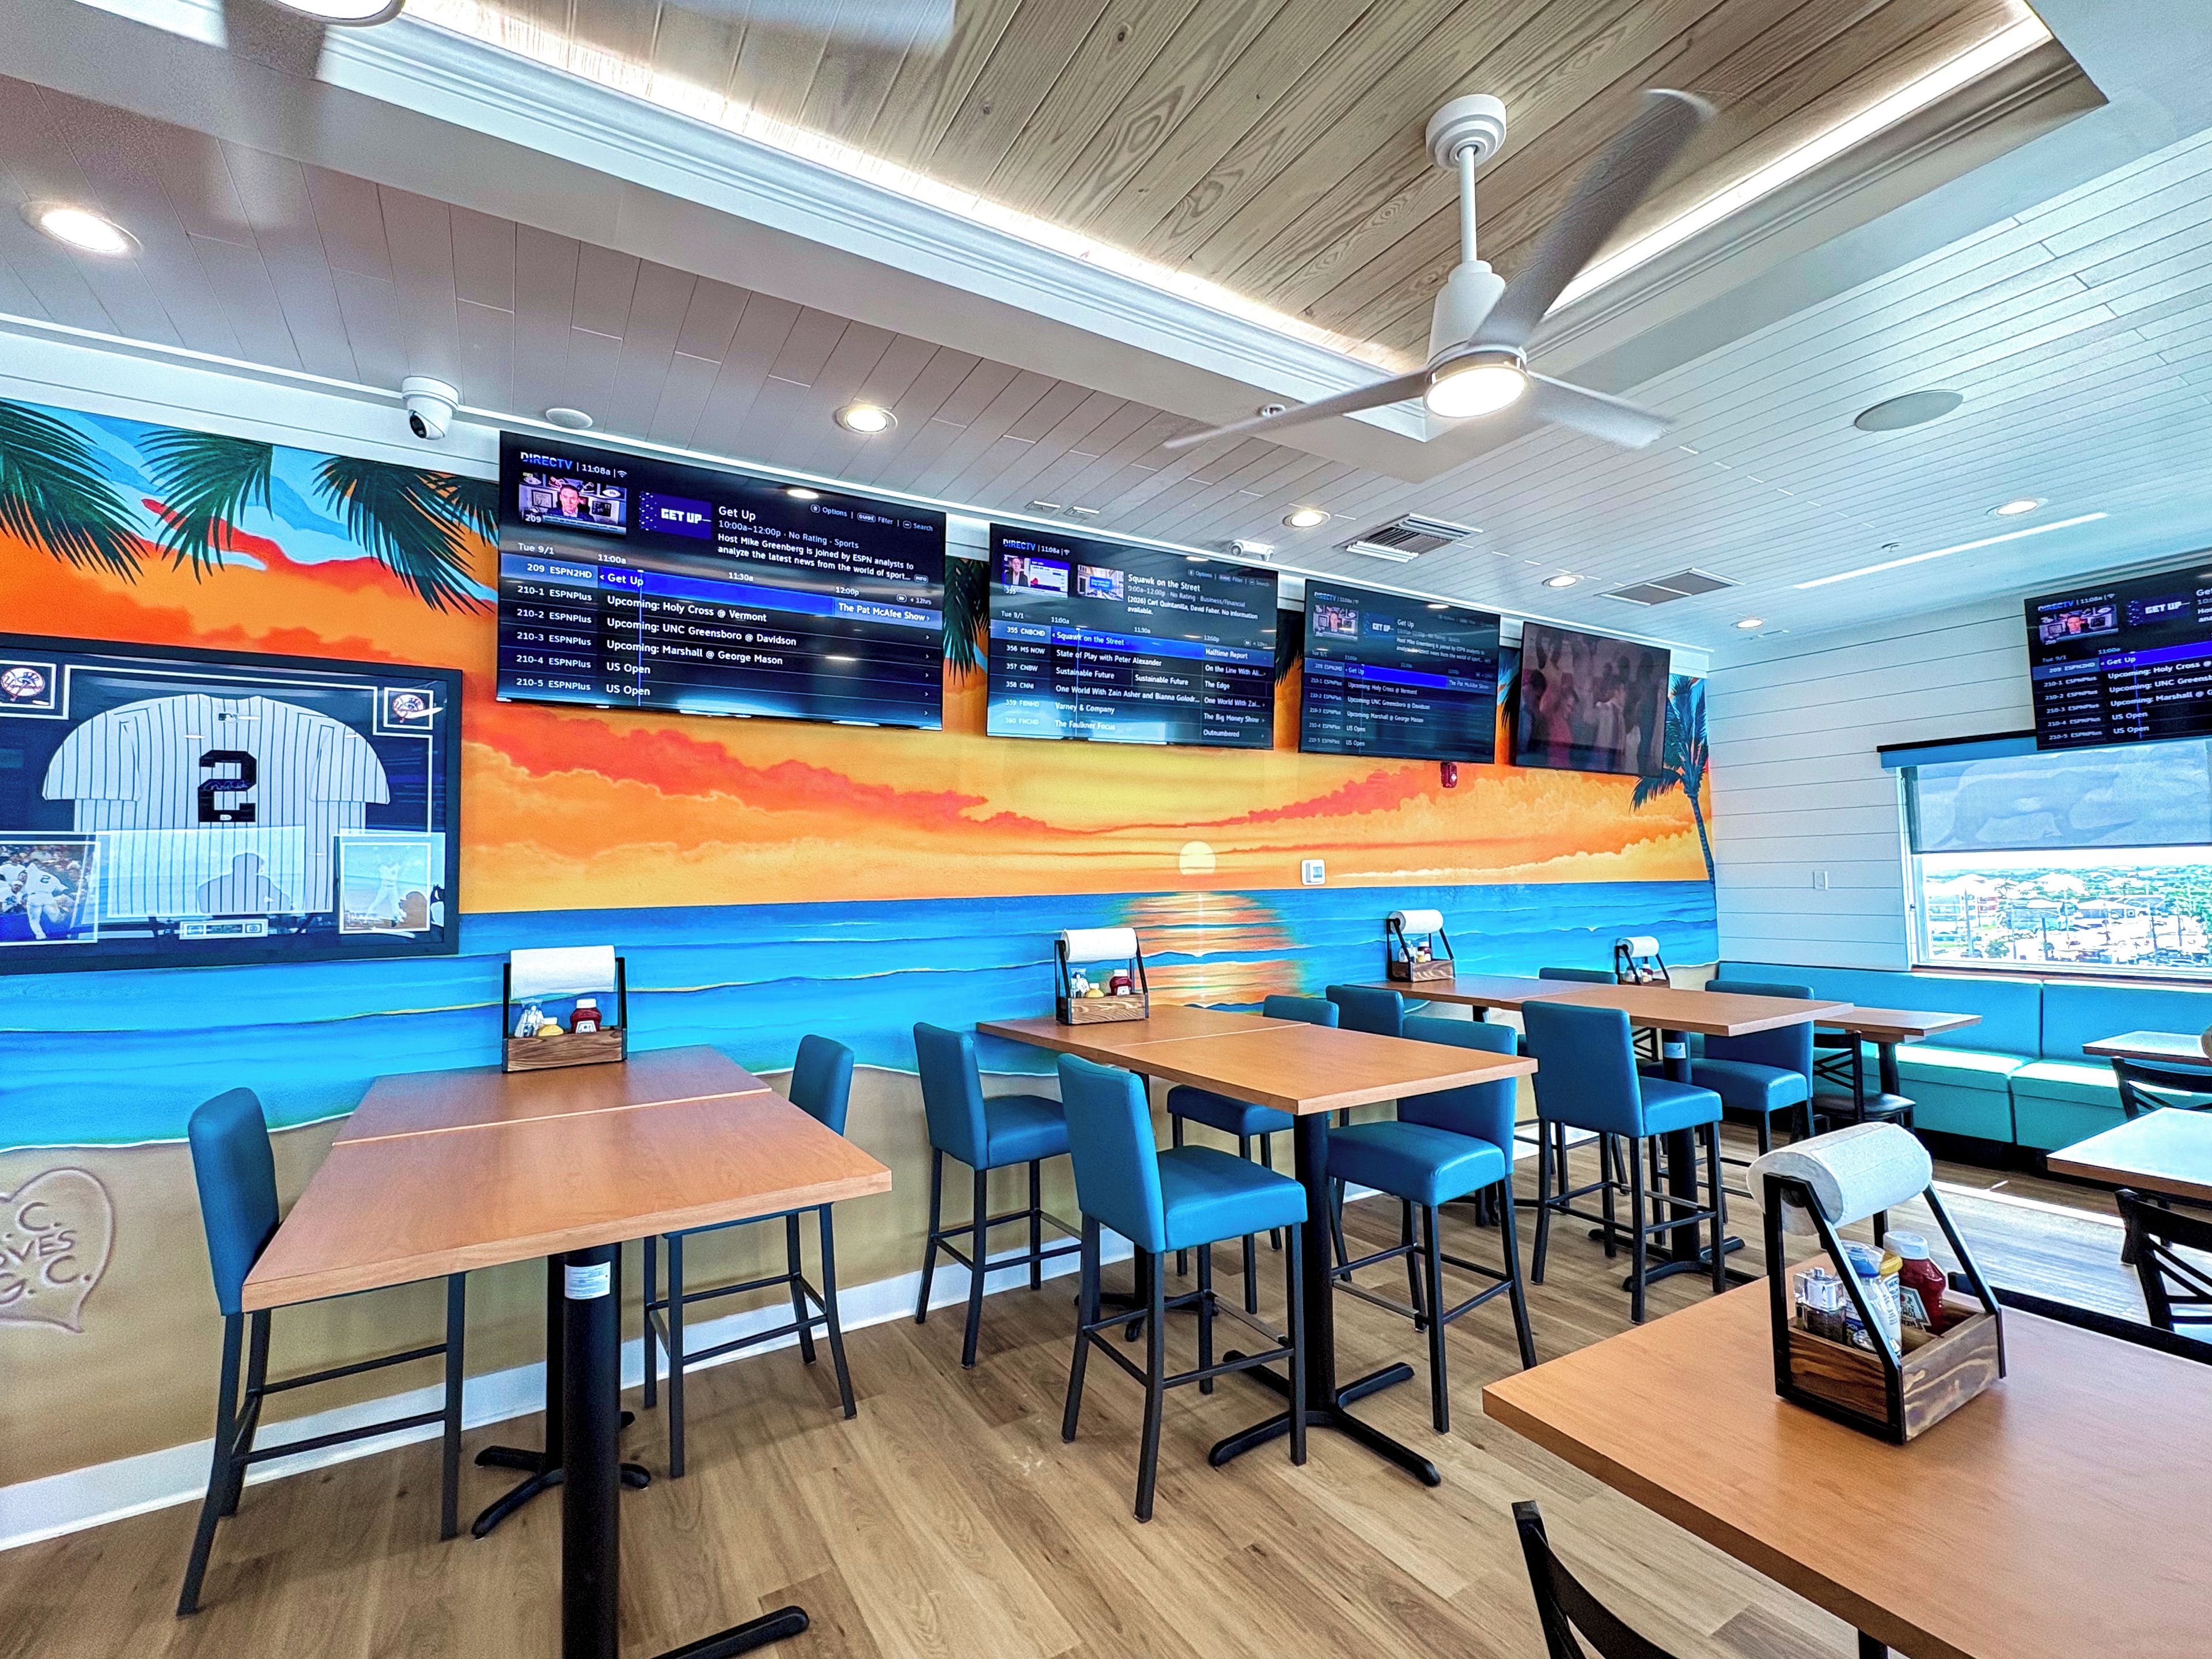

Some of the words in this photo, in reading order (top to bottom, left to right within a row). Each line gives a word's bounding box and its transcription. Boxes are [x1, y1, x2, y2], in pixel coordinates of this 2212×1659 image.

[521, 452, 573, 469] DIRECTV
[582, 464, 611, 475] 11:08a
[525, 514, 541, 522] 209
[661, 508, 684, 521] GET
[687, 513, 702, 524] UP
[719, 506, 738, 518] Get
[742, 510, 756, 522] Up
[823, 507, 847, 517] Options
[913, 523, 933, 532] Search
[803, 533, 827, 546] Rating
[834, 539, 859, 548] Sports
[1003, 539, 1036, 551] DIRECTV
[518, 543, 535, 552] Tue
[538, 546, 554, 555] 9/1
[718, 534, 738, 543] Host
[741, 536, 759, 546] Mike
[762, 540, 804, 555] Greenberg
[815, 549, 839, 558] joined
[842, 552, 850, 562] by
[853, 554, 872, 563] ESPN
[874, 558, 904, 569] analysts
[598, 554, 626, 564] 11:00a
[718, 546, 749, 557] analyze
[752, 550, 765, 559] the
[769, 552, 791, 563] latest
[794, 558, 815, 566] news
[817, 560, 835, 569] from
[853, 566, 874, 575] world
[527, 564, 544, 572] 209
[550, 567, 592, 578] ESPN2HD
[729, 572, 753, 581] 11:30a
[608, 574, 626, 583] Get
[630, 576, 643, 587] Up
[1128, 574, 1154, 585] Squawk
[1181, 582, 1200, 592] Street
[518, 586, 544, 596] 210-1
[550, 589, 592, 601] ESPNPlus
[836, 586, 859, 596] 12:00p
[607, 595, 660, 611] Upcoming:
[663, 603, 684, 613] Holy
[688, 605, 714, 616] Cross
[717, 610, 725, 618] @
[729, 609, 767, 622] Vermont
[839, 603, 854, 612] The
[857, 605, 870, 615] Pat
[873, 608, 902, 618] McAfee
[904, 612, 925, 621] Show
[2145, 605, 2165, 614] GET
[517, 609, 544, 619] 210-2
[550, 612, 592, 623] ESPNPlus
[517, 632, 544, 641] 210-3
[549, 635, 591, 645] ESPNPlus
[607, 618, 660, 632] Upcoming:
[662, 624, 684, 634] UNC
[688, 627, 742, 640] Greensboro
[745, 634, 753, 642] @
[757, 634, 796, 646] Davidson
[1056, 632, 1082, 641] Squawk
[607, 640, 659, 654] Upcoming:
[662, 646, 702, 657] Marshall
[706, 651, 714, 659] @
[718, 652, 751, 663] George
[755, 655, 783, 665] Mason
[1084, 652, 1097, 661] Play
[1132, 657, 1162, 666] Alexander
[1206, 649, 1228, 657] Halftime
[1230, 651, 1248, 659] Report
[517, 655, 543, 664] 210-4
[549, 658, 591, 668] ESPNPlus
[607, 662, 620, 671] US
[624, 664, 650, 675] Open
[1056, 668, 1092, 676] Sustainable
[1095, 671, 1115, 679] Future
[2108, 669, 2152, 679] Upcoming:
[517, 678, 543, 687] 210-5
[548, 680, 590, 690] ESPNPlus
[1135, 675, 1168, 683] Sustainable
[607, 684, 620, 692] US
[624, 686, 650, 696] Open
[2109, 683, 2152, 693] Upcoming:
[1055, 702, 1077, 712] Varney
[1086, 705, 1115, 715] Company
[1069, 721, 1096, 729] Faulkner
[1215, 714, 1224, 722] Big
[1226, 715, 1244, 723] Money
[198, 750, 257, 823] 2
